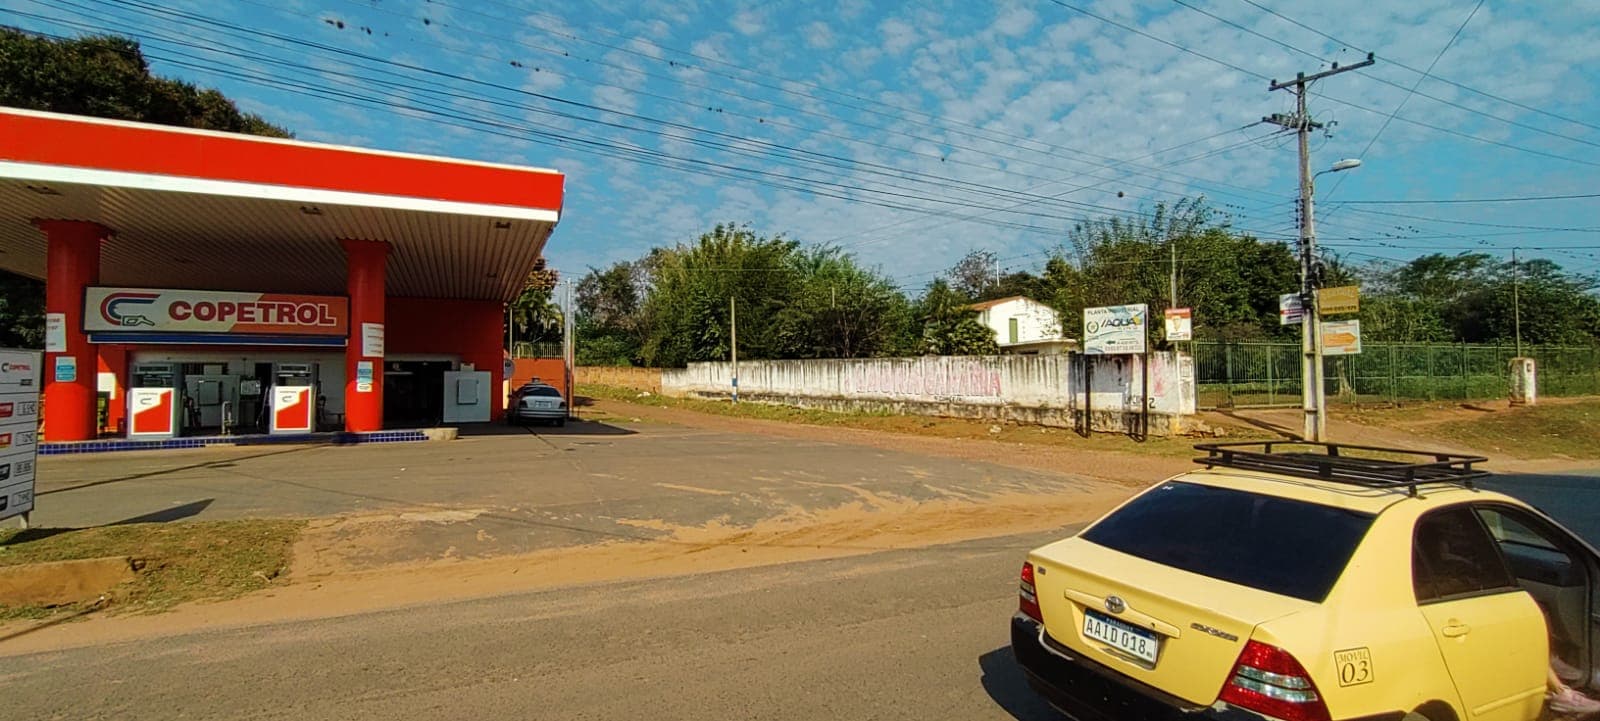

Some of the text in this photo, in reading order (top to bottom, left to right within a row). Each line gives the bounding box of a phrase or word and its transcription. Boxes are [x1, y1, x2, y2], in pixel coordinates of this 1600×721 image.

[168, 300, 336, 326] COPETROL
[1148, 397, 1156, 409] 2
[1086, 619, 1146, 654] AAID 018
[1338, 650, 1369, 663] MOVIL
[1342, 660, 1369, 684] 03
